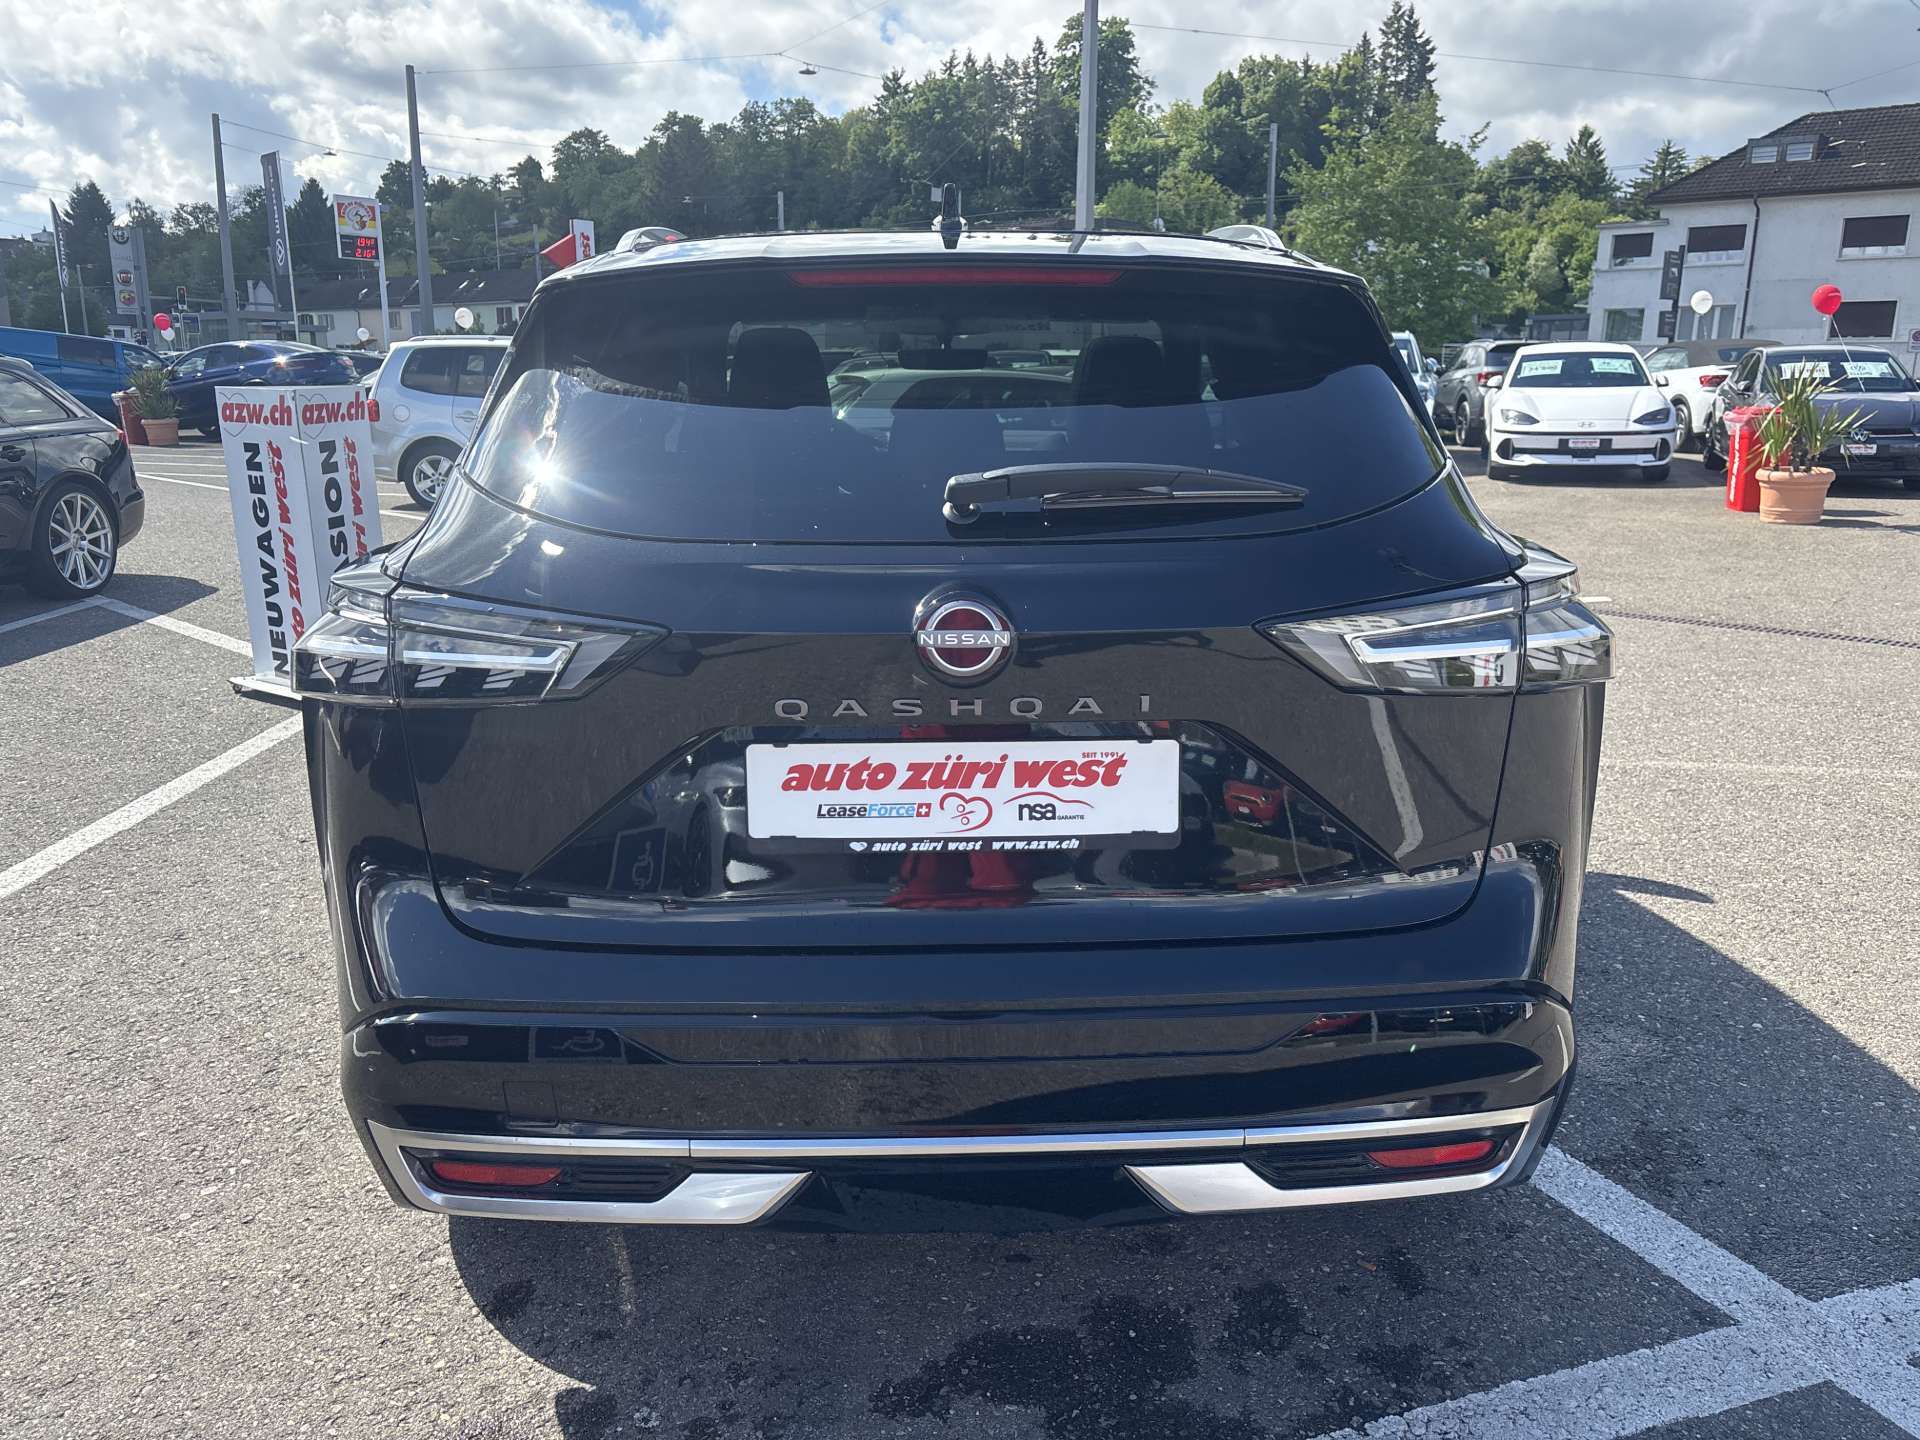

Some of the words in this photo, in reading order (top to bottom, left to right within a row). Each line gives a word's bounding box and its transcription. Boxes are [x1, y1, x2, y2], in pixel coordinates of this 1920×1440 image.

[222, 395, 292, 426] azw.ch
[302, 391, 365, 426] azw.ch
[266, 439, 293, 525] west
[342, 435, 364, 516] west
[243, 441, 290, 676] NEUWAGEN
[278, 527, 303, 607] züri
[920, 633, 1009, 645] NISSAN
[774, 695, 1150, 721] QASHQAI
[781, 756, 896, 792] auto
[898, 753, 1009, 790] züri
[1014, 753, 1128, 789] west
[817, 803, 916, 818] LeaseForce
[1018, 803, 1056, 821] nsa
[872, 840, 907, 852] auto
[910, 840, 943, 851] züri
[948, 840, 983, 851] west
[991, 838, 1080, 850] www.azw.ch
